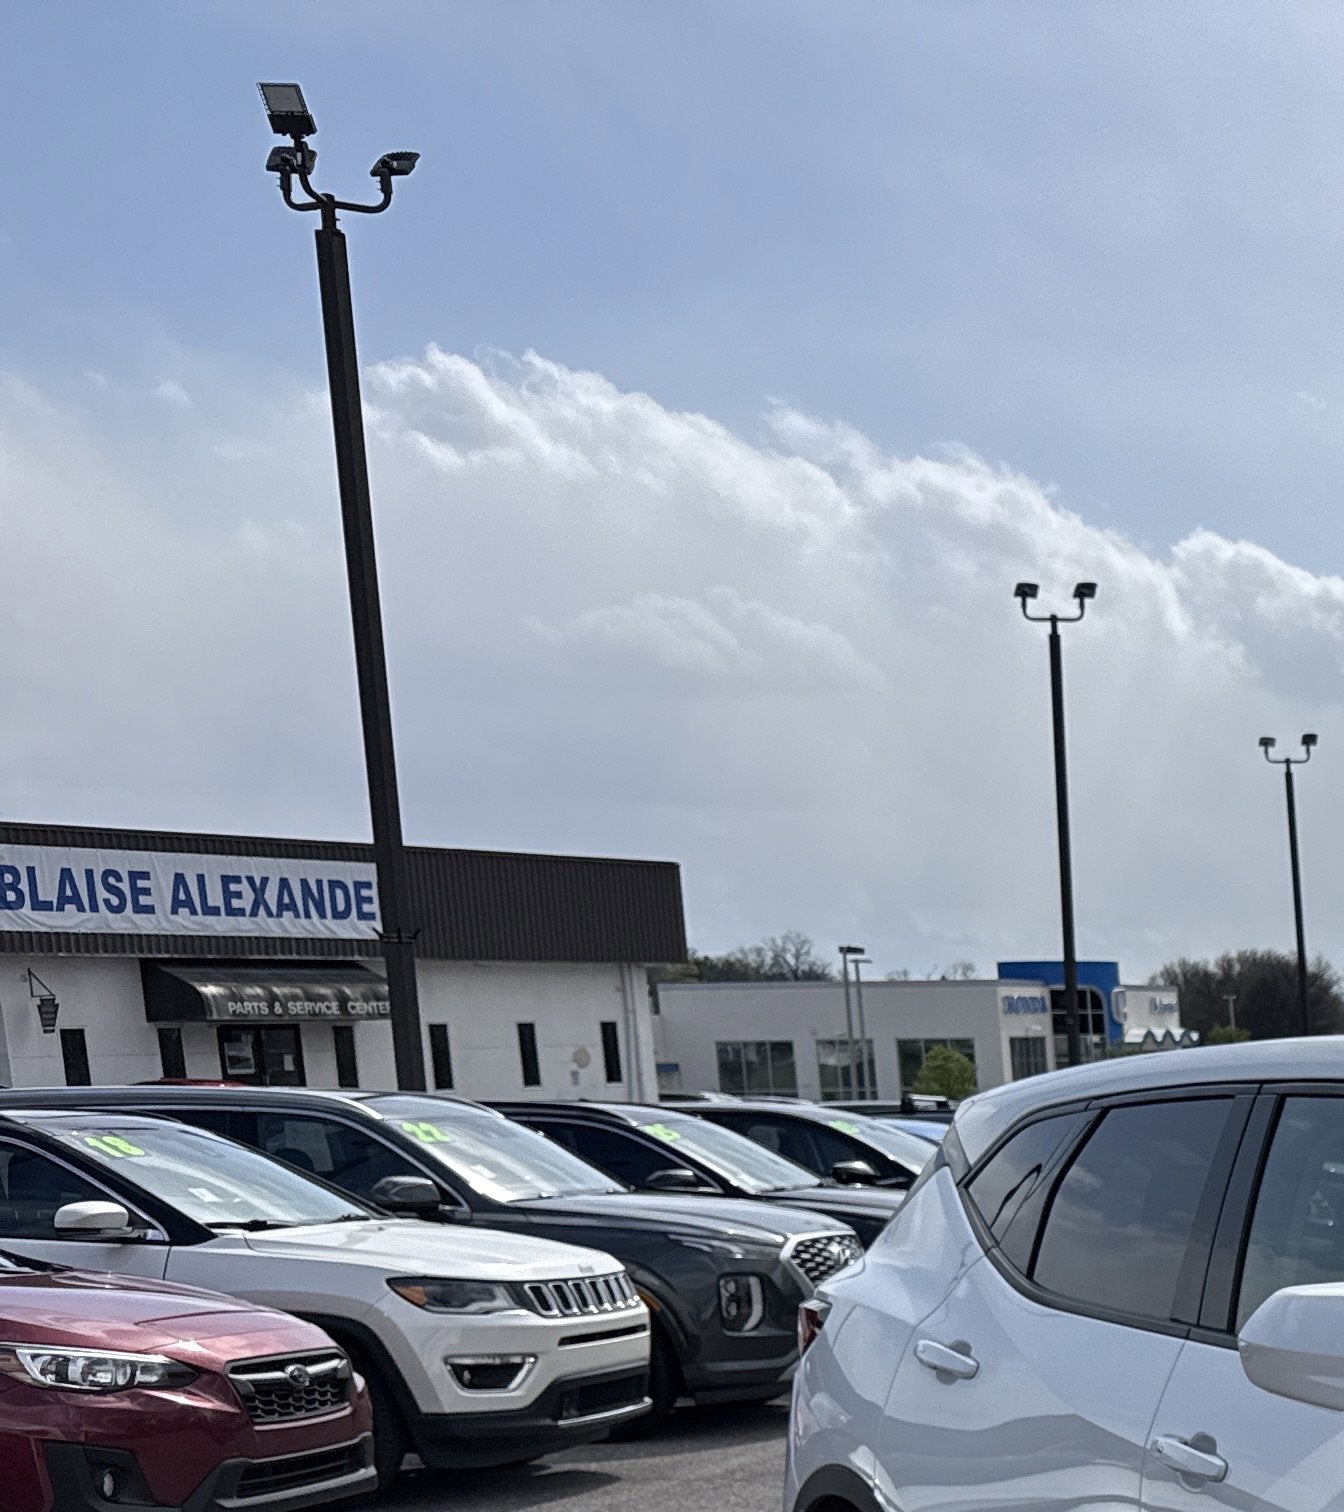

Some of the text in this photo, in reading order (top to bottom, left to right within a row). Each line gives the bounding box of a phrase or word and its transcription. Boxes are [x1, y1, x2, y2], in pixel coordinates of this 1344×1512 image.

[0, 864, 378, 922] BLAISE ALEXANDE
[227, 1001, 269, 1015] PARTS
[274, 1001, 283, 1015] &
[288, 1001, 341, 1015] SERVICE
